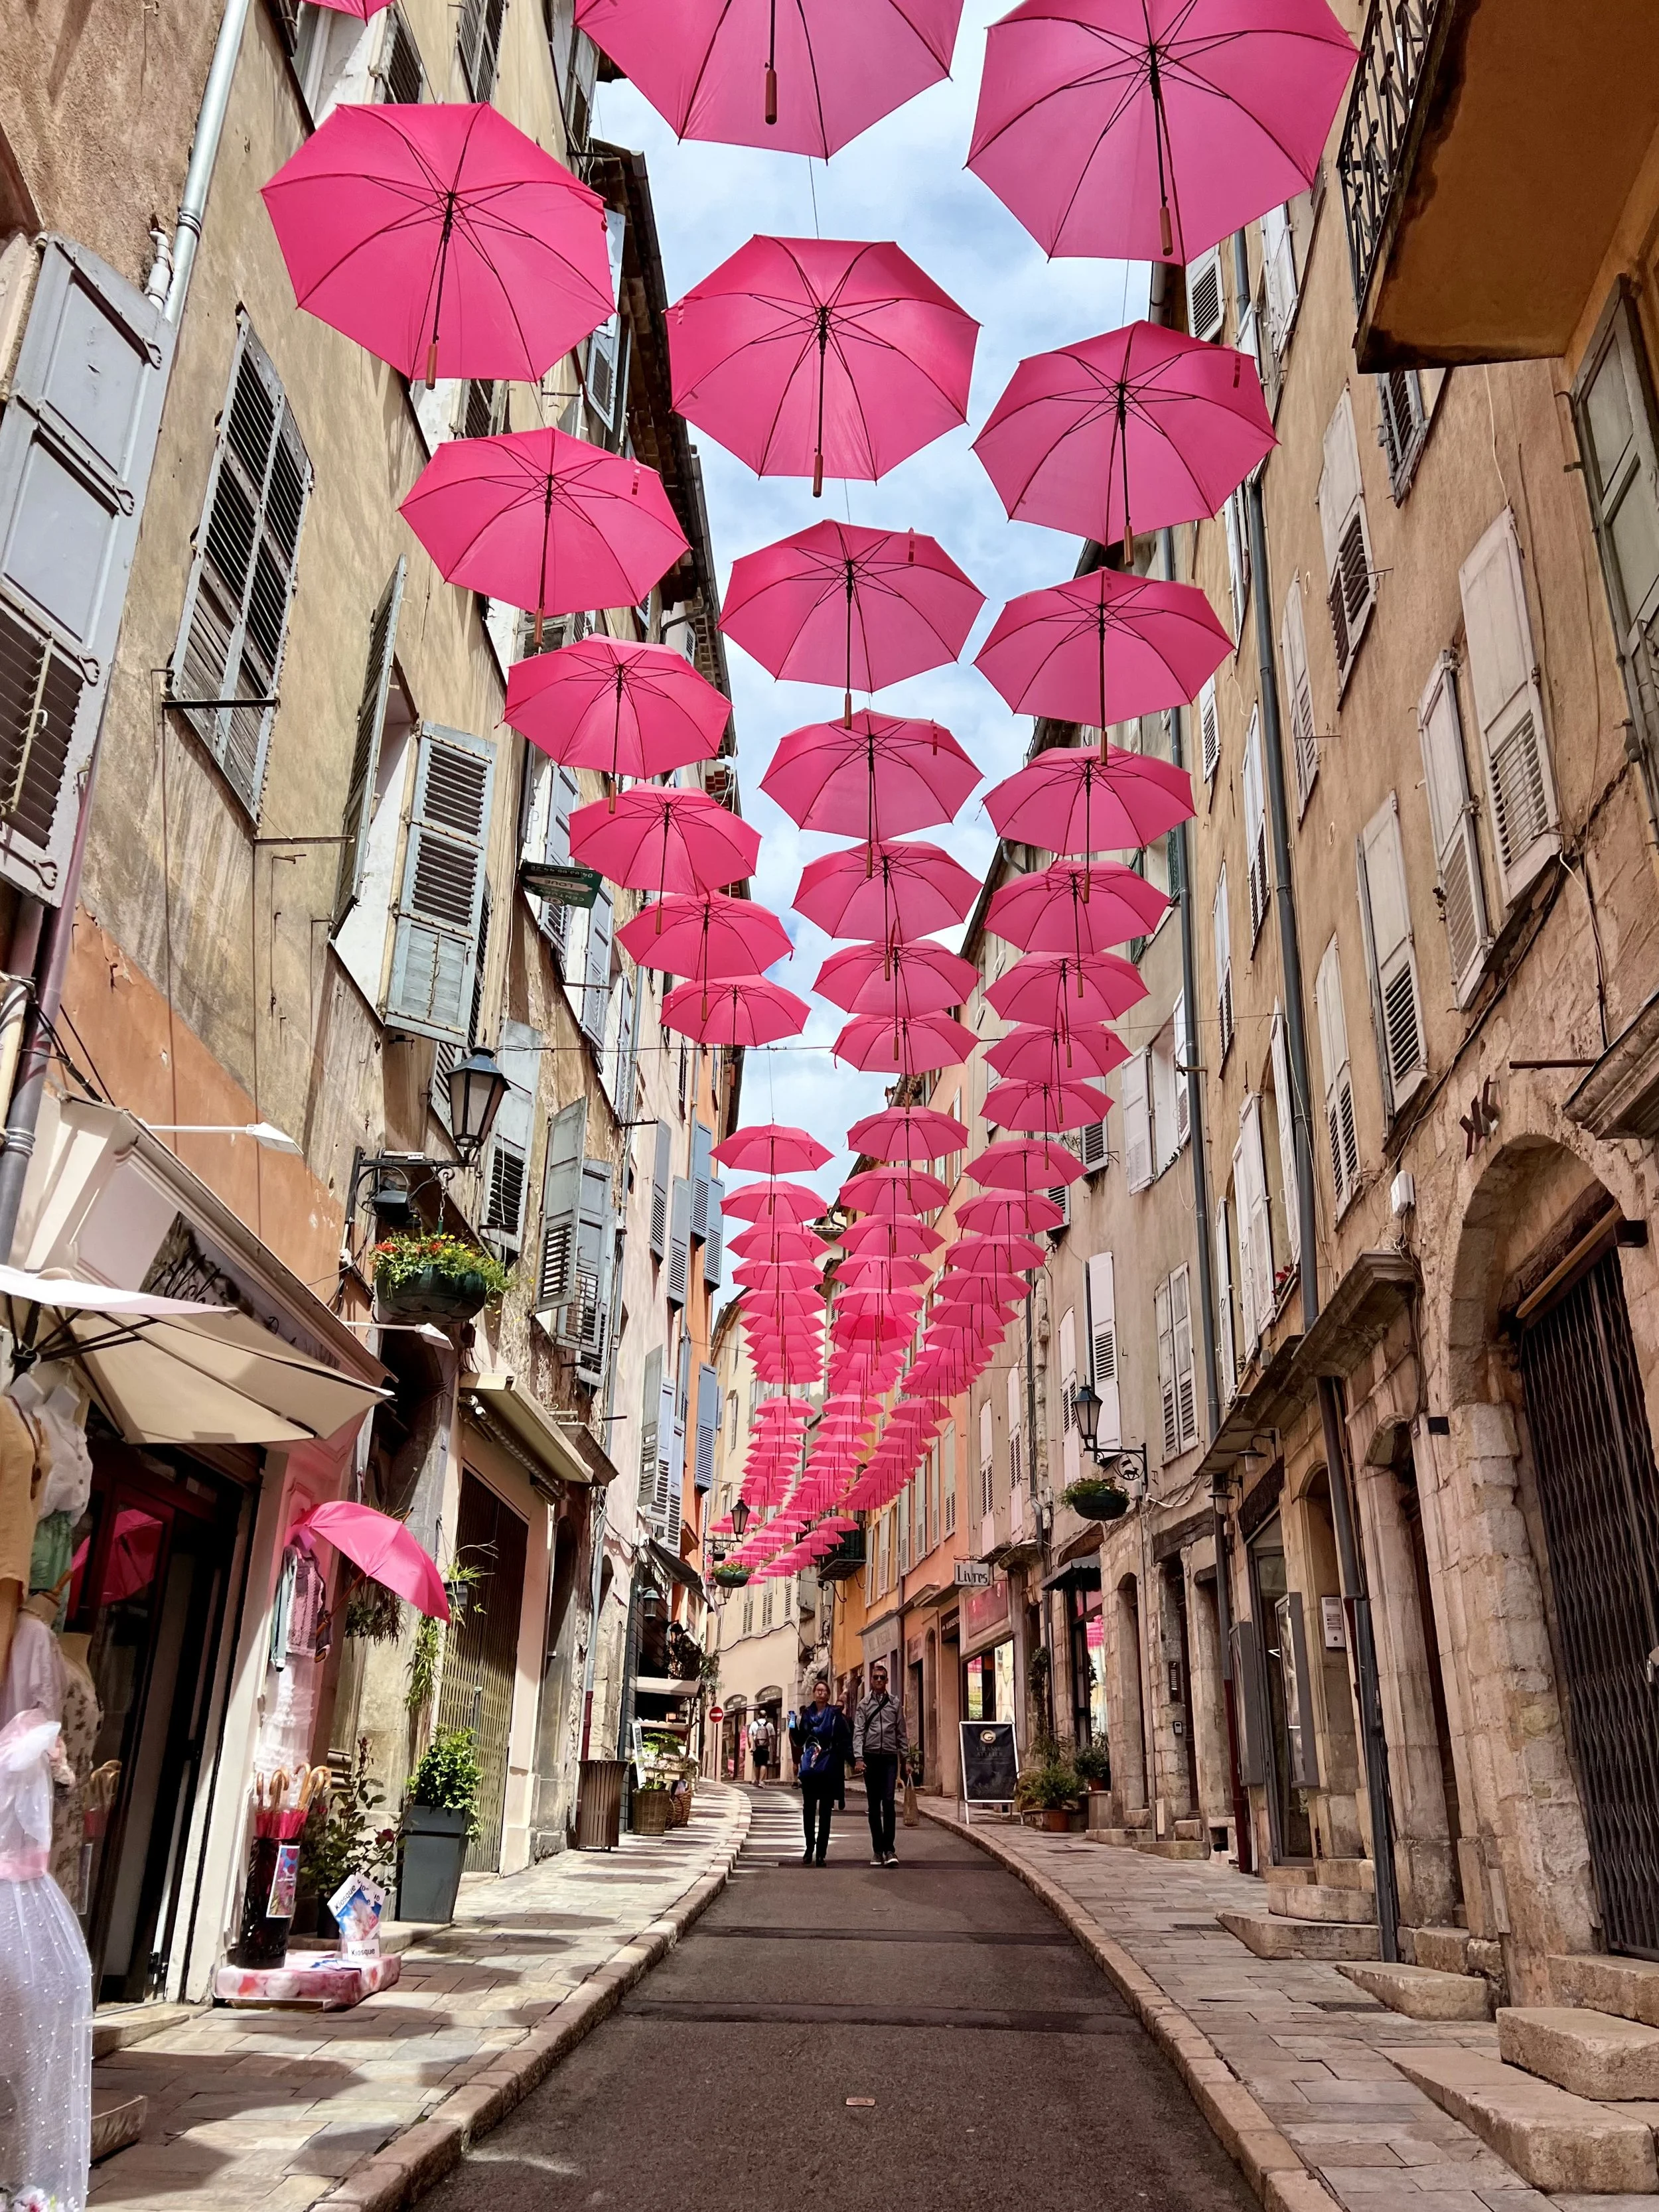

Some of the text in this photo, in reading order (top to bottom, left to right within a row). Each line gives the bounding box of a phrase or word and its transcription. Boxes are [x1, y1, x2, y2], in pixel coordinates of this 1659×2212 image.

[538, 887, 585, 902] CENTURY
[957, 1565, 987, 1584] Livres
[334, 1885, 356, 1911] Kiosque
[351, 1948, 376, 1957] Kiosque
